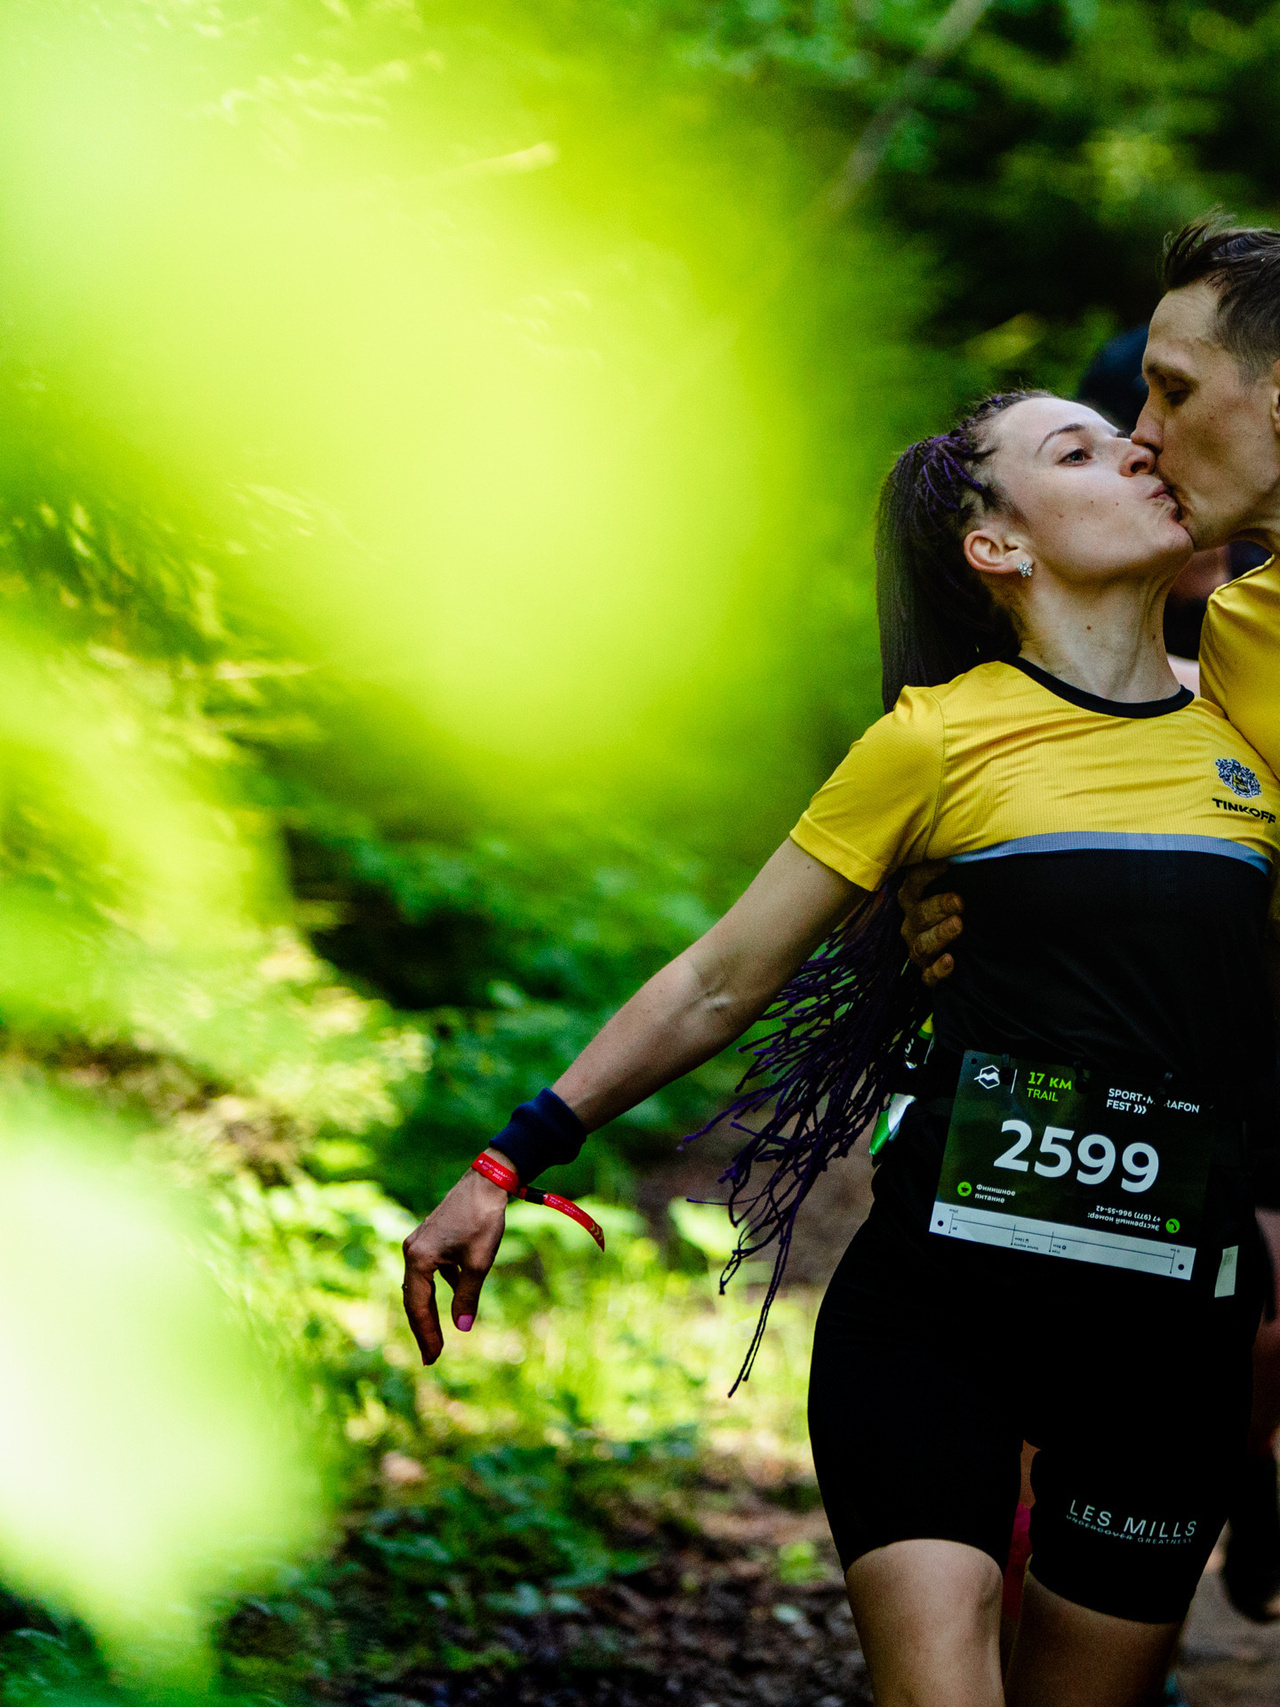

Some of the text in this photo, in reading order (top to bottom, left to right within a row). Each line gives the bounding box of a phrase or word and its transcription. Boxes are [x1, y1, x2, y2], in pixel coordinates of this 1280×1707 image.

[1212, 798, 1276, 824] TINKOFF
[1028, 1071, 1072, 1091] 17 KM
[1026, 1087, 1059, 1103] TRAIL
[1106, 1099, 1131, 1112] FEST
[993, 1119, 1160, 1193] 2599
[1069, 1499, 1197, 1538] LES MILLS
